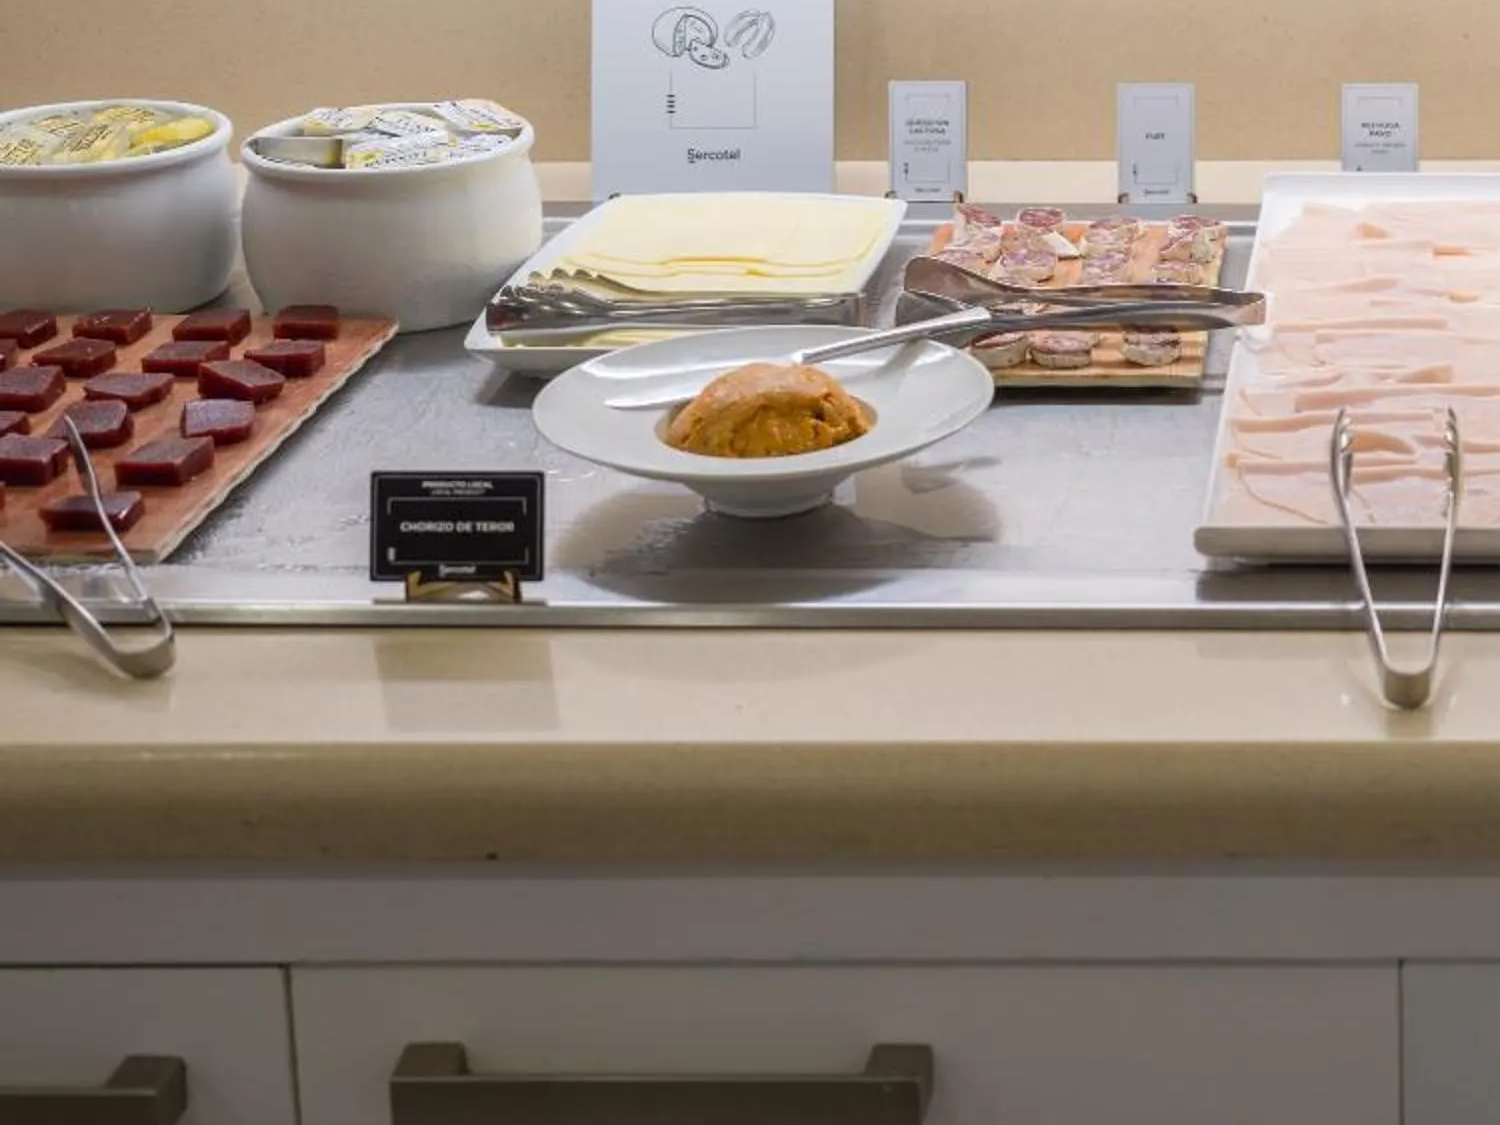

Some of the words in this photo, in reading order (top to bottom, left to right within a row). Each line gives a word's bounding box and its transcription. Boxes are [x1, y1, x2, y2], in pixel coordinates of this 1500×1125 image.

[687, 148, 741, 164] Sercotel
[400, 520, 454, 534] CHORIZO
[455, 520, 472, 534] DE
[476, 520, 515, 534] TEROR
